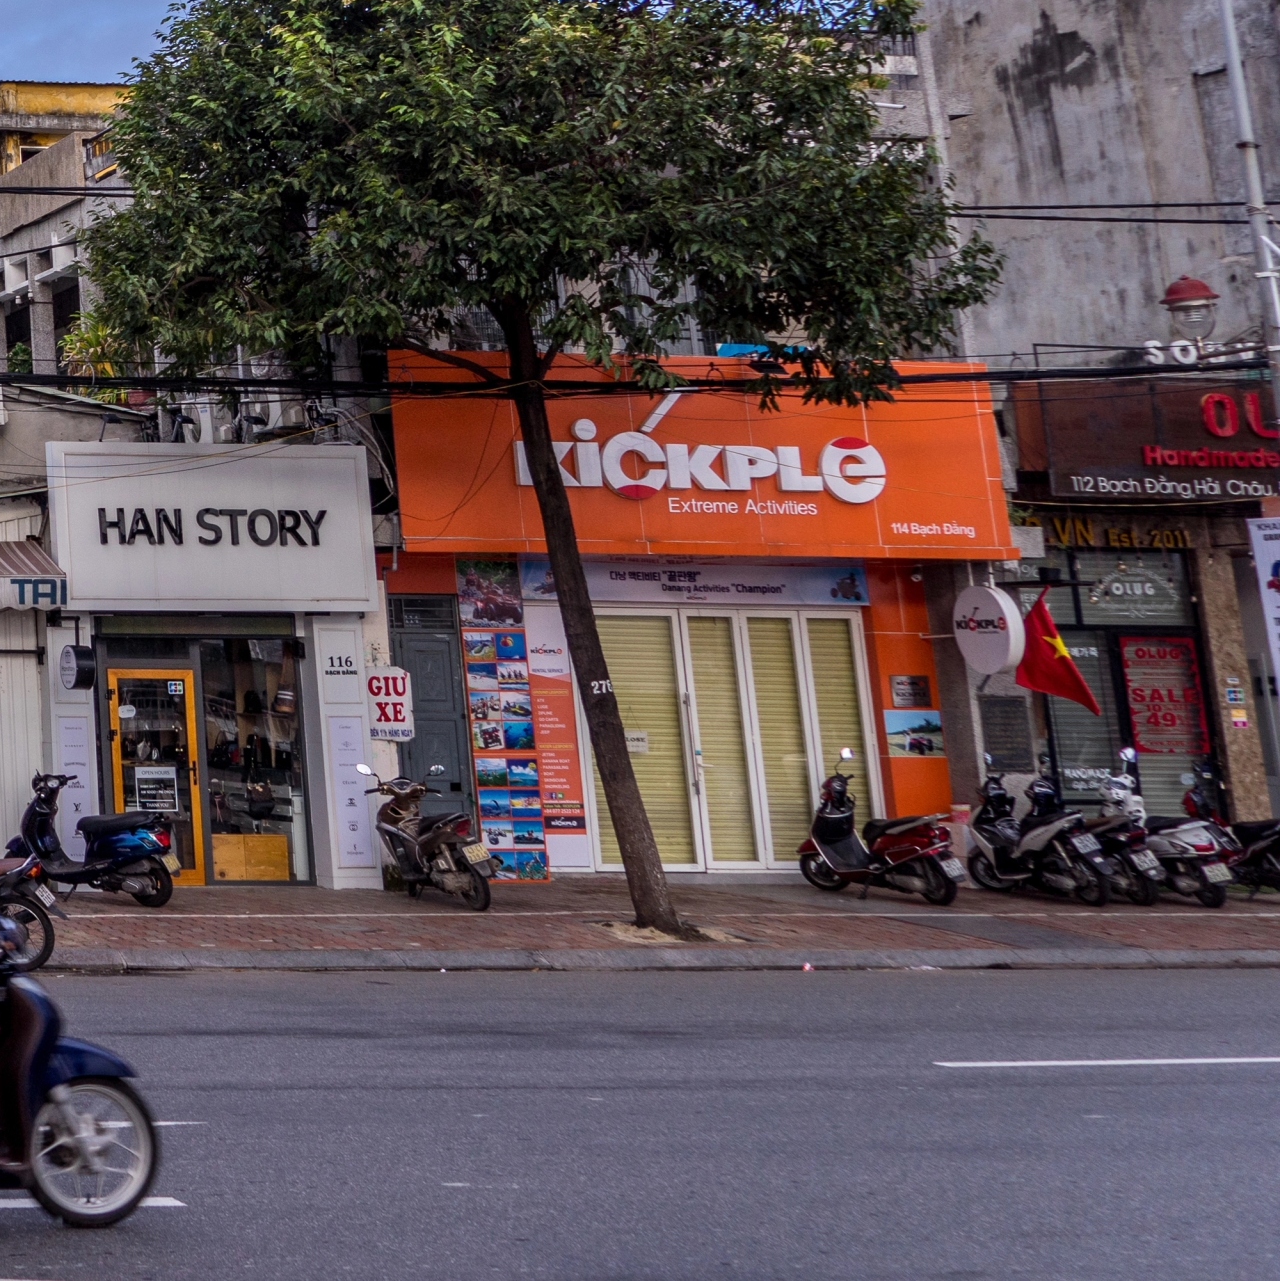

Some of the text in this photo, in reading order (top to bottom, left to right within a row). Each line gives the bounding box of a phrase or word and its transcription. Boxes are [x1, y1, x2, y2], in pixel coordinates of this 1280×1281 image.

[1142, 444, 1280, 468] Handmade
[1070, 475, 1095, 492] 112
[1097, 477, 1141, 496] Bạch
[668, 498, 818, 516] Extreme Activities
[97, 507, 328, 547] HAN STORY
[890, 521, 976, 539] 114 Bạch Đằng
[610, 570, 626, 581] 다낭
[661, 583, 786, 595] Danang Activities "Champion"
[328, 655, 353, 668] 116
[1134, 647, 1182, 660] OLUG
[1131, 688, 1199, 703] SALE
[375, 702, 406, 723] XE
